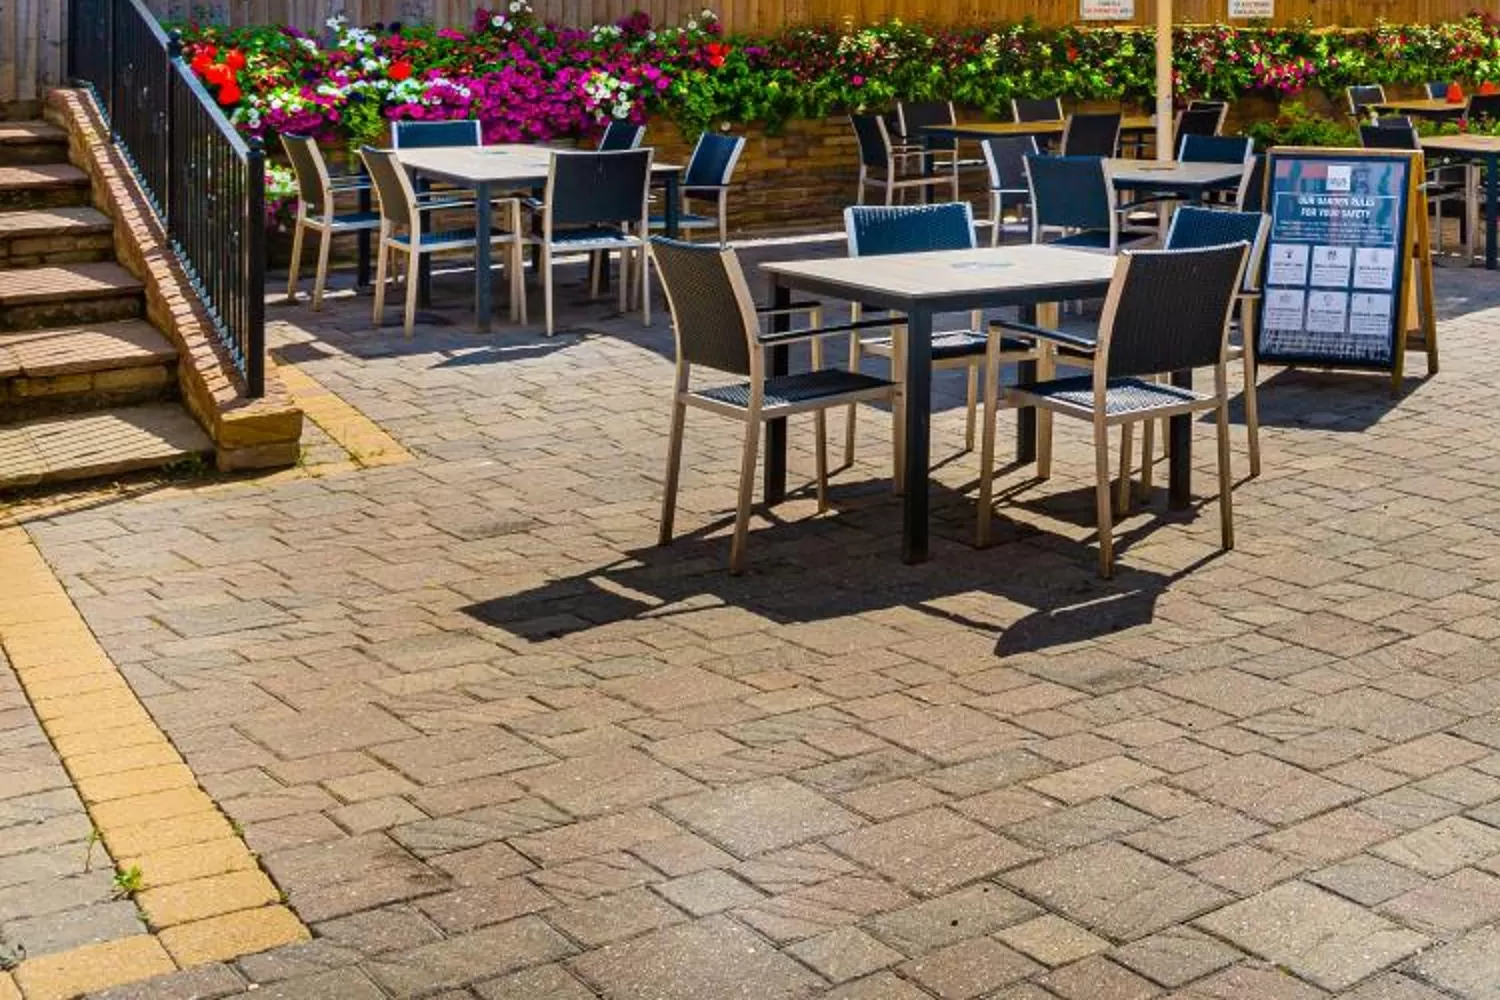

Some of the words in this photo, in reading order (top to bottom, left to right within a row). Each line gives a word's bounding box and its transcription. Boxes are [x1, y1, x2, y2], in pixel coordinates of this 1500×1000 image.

[1298, 195, 1315, 204] OUR
[1301, 207, 1316, 217] FOR
[1319, 208, 1340, 217] YOUR
[1342, 209, 1370, 219] SAFETY
